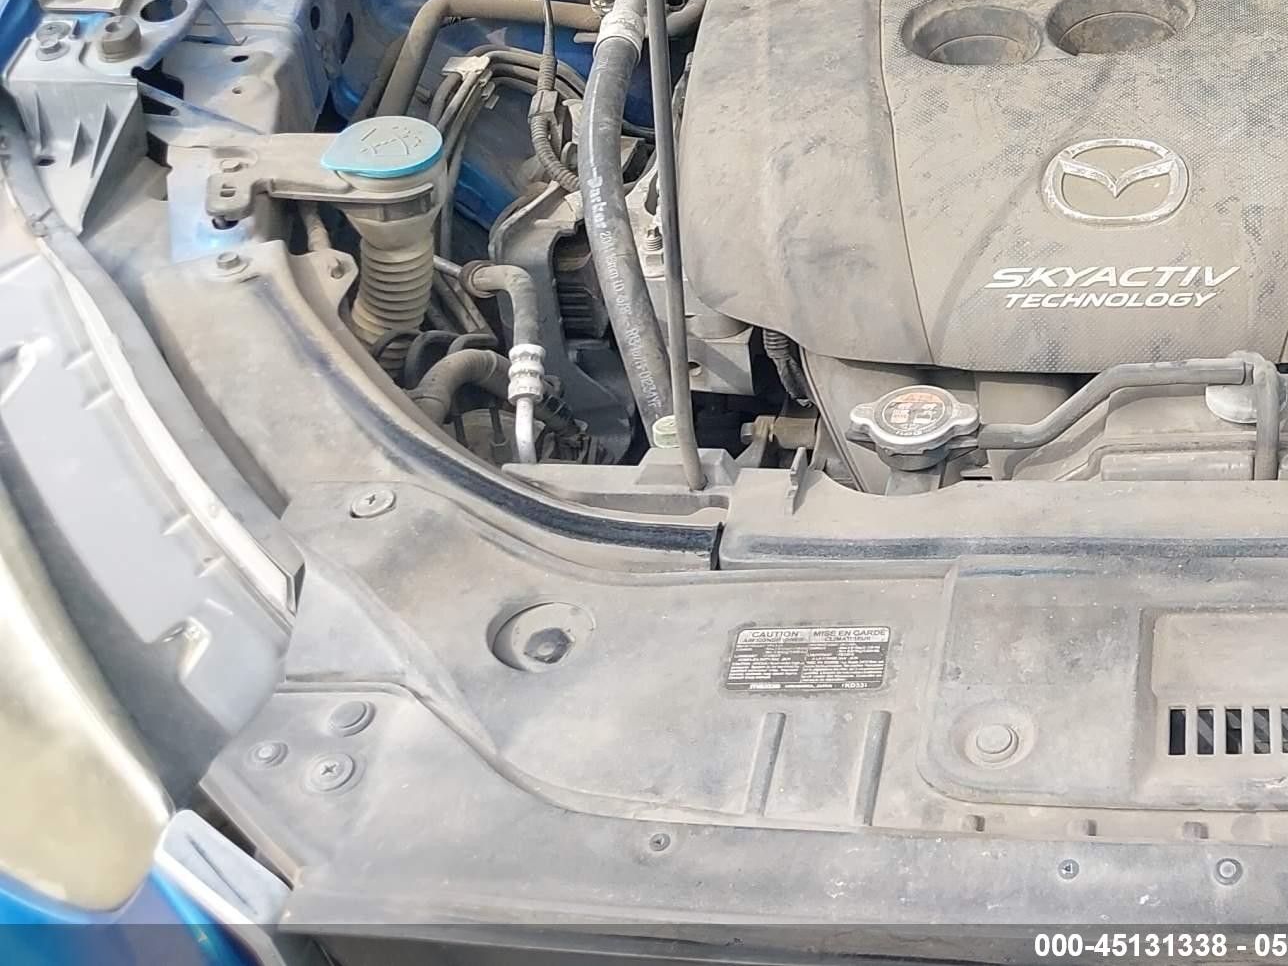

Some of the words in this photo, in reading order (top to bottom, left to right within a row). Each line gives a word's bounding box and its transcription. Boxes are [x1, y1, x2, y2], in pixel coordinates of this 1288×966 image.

[586, 175, 607, 229] Parker
[984, 266, 1240, 289] SKYACTIV
[1004, 292, 1218, 309] TECHNOLOGY
